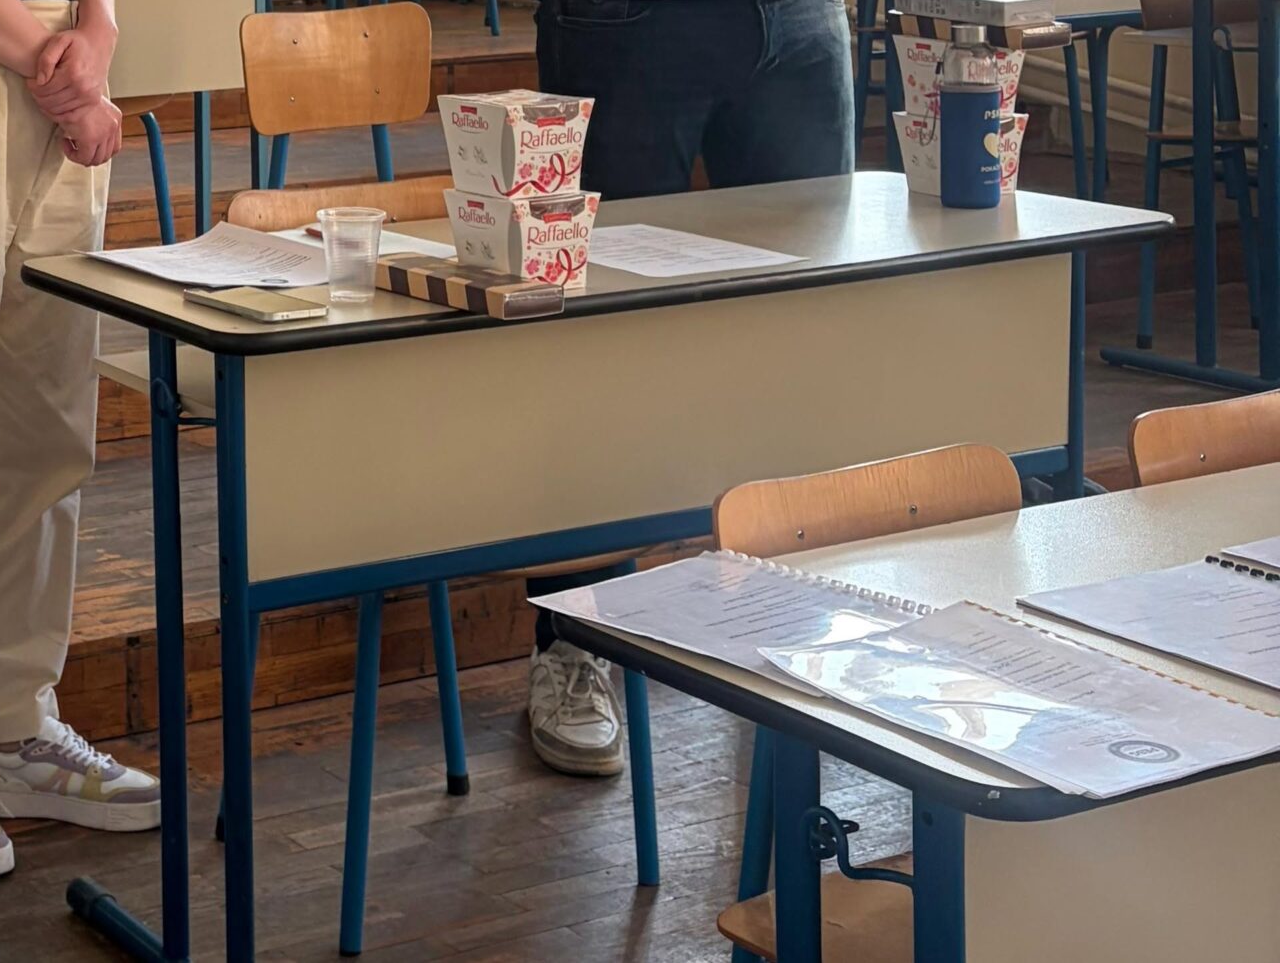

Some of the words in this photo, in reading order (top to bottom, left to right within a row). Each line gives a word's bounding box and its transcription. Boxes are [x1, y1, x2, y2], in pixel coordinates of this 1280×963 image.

[451, 112, 489, 130] Raffaello
[520, 127, 582, 149] Raffaello
[457, 206, 496, 226] Raffaello
[527, 223, 589, 245] Raffaello
